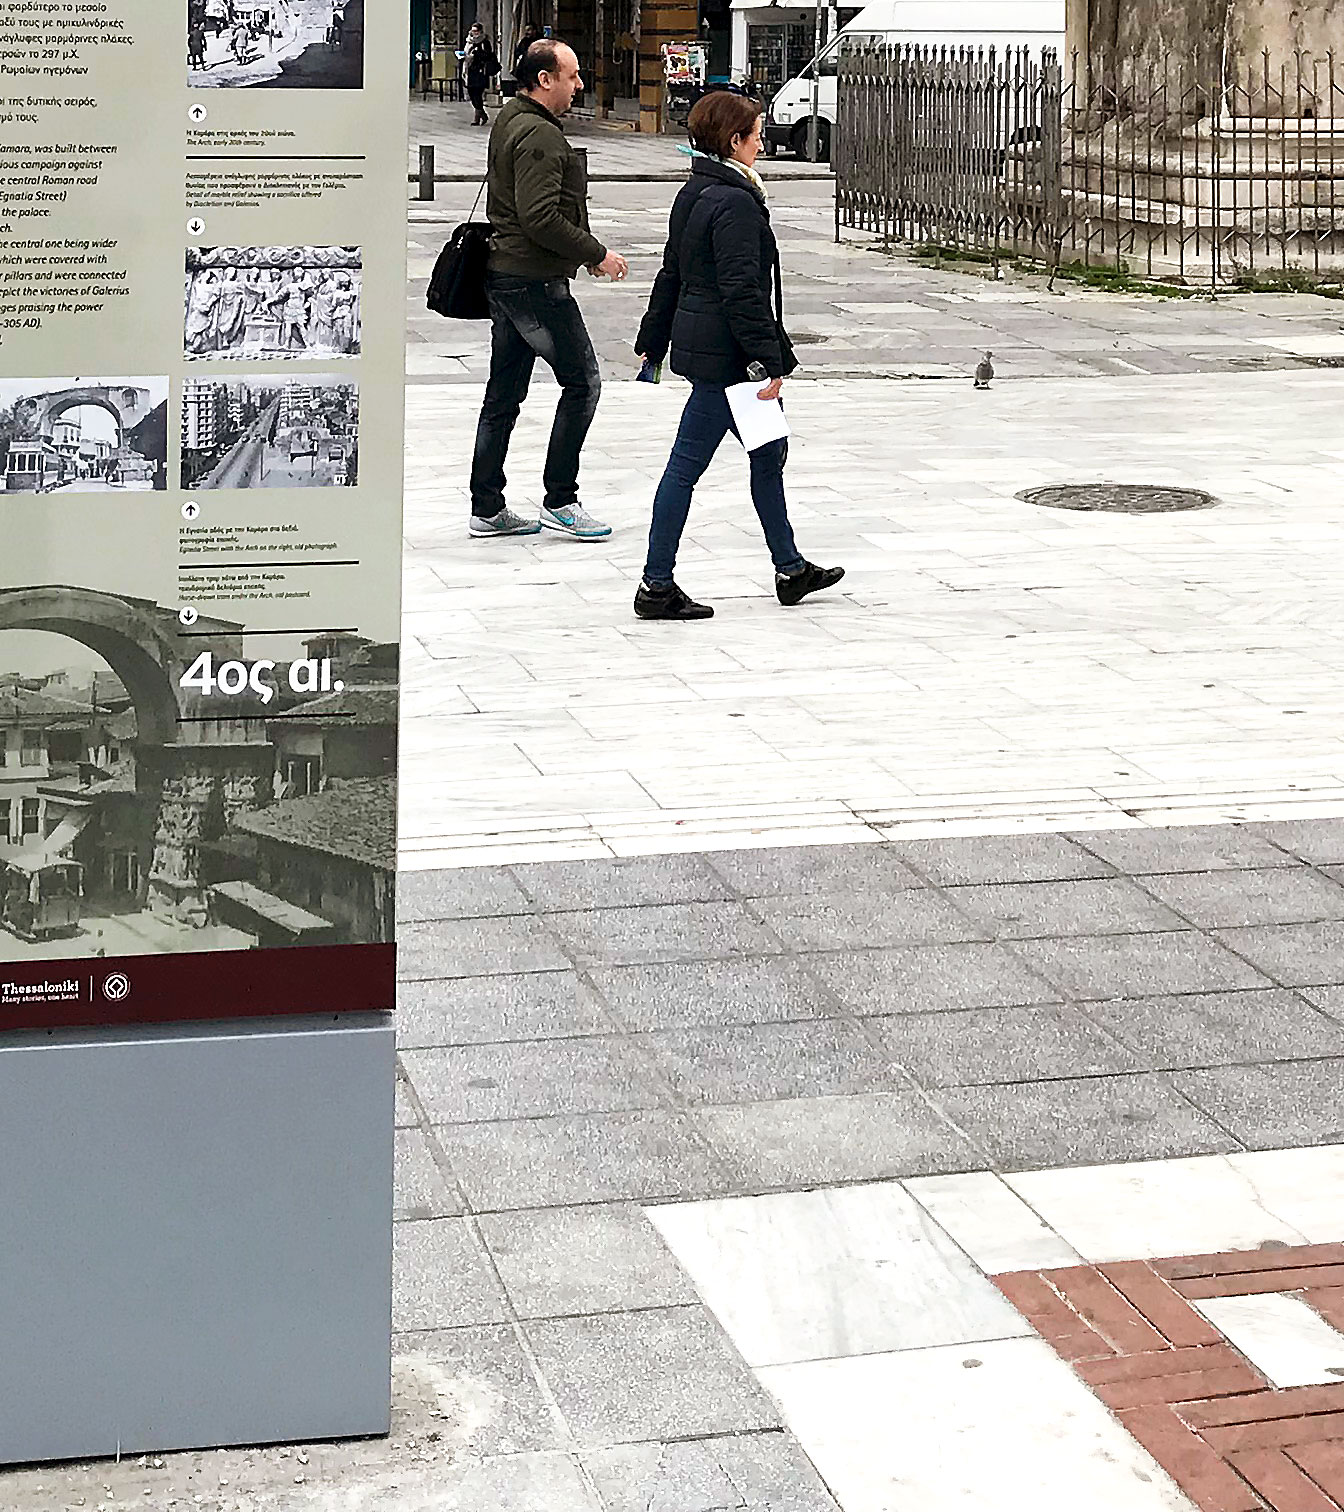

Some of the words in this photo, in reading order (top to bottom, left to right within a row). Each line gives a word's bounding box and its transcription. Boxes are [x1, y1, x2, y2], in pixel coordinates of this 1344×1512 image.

[35, 145, 53, 154] was
[55, 144, 76, 154] built
[78, 144, 117, 154] between
[21, 159, 66, 172] campaign
[68, 159, 102, 172] against
[8, 175, 40, 186] central
[42, 173, 74, 186] Roman
[76, 174, 98, 185] road
[35, 190, 67, 202] Street)
[179, 650, 276, 705] 4ος
[287, 657, 346, 693] αι.
[1, 979, 80, 996] Thessaloniki
[1, 995, 21, 1005] Many
